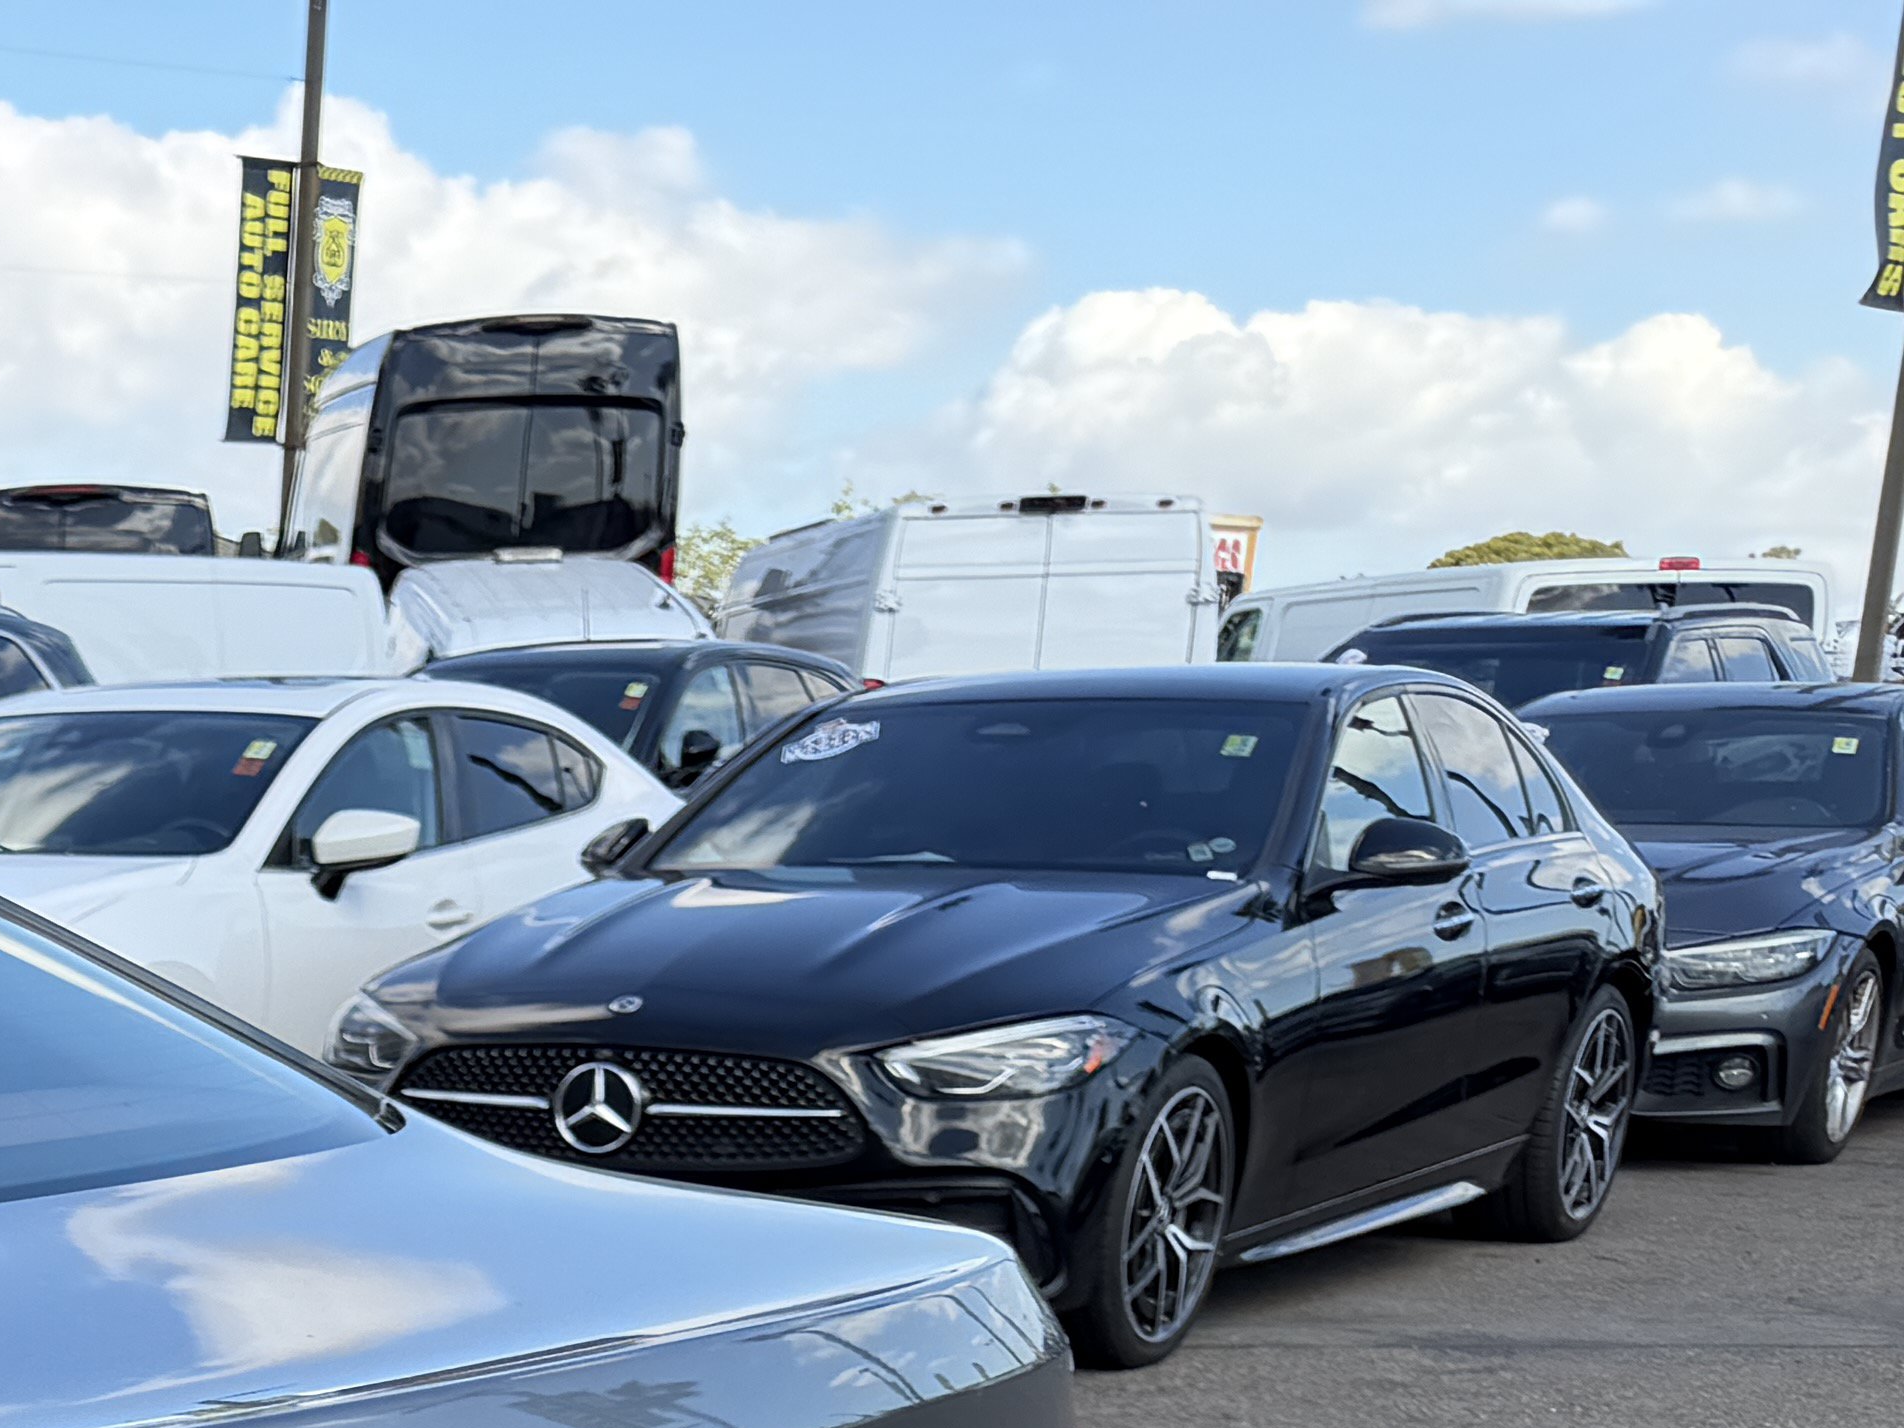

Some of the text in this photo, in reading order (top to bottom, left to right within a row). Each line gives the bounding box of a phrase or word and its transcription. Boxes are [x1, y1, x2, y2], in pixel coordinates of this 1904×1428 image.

[230, 192, 266, 409] AUTO CARE
[252, 169, 291, 437] FULL SERVICE
